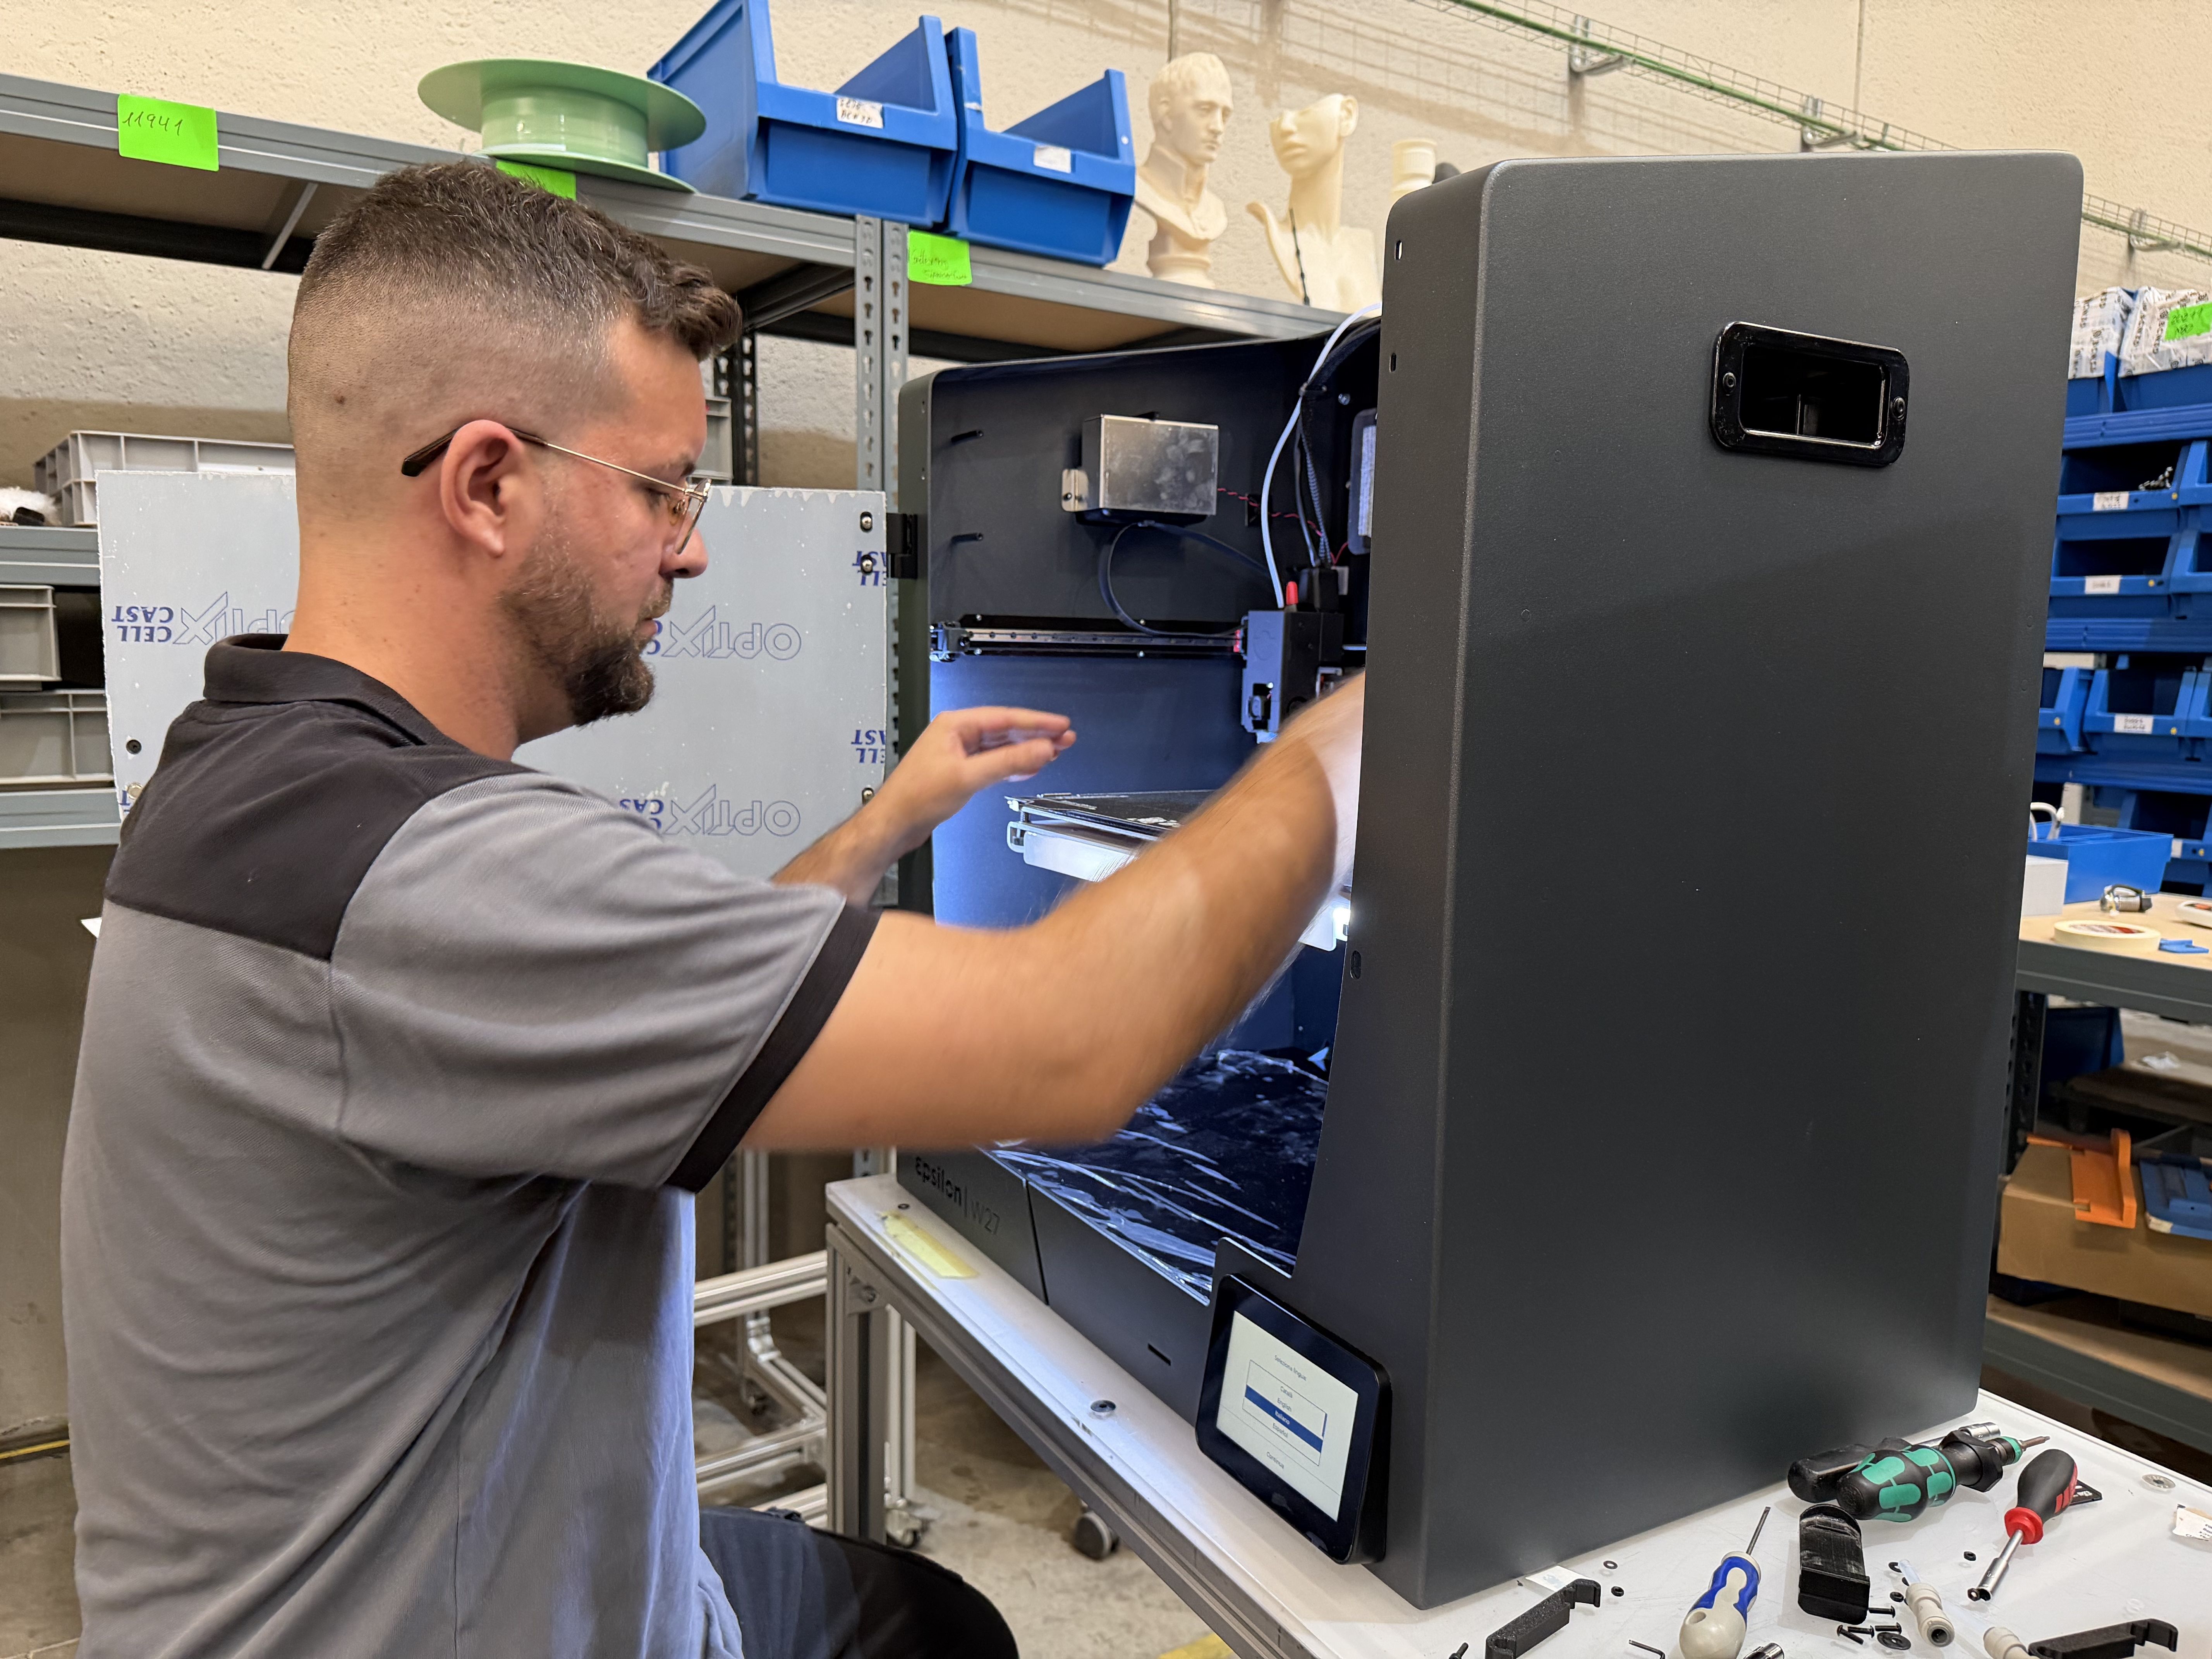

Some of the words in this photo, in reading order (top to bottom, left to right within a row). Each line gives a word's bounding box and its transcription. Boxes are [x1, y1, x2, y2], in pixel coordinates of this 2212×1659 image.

[122, 111, 183, 136] 11941
[112, 606, 173, 623] CAST
[117, 626, 172, 642] CELL
[661, 605, 802, 661] OPTIX
[663, 784, 800, 837] OPTIX
[1277, 1397, 1292, 1412] English
[1275, 1410, 1290, 1425] Italiano
[1266, 1451, 1284, 1469] Continua
